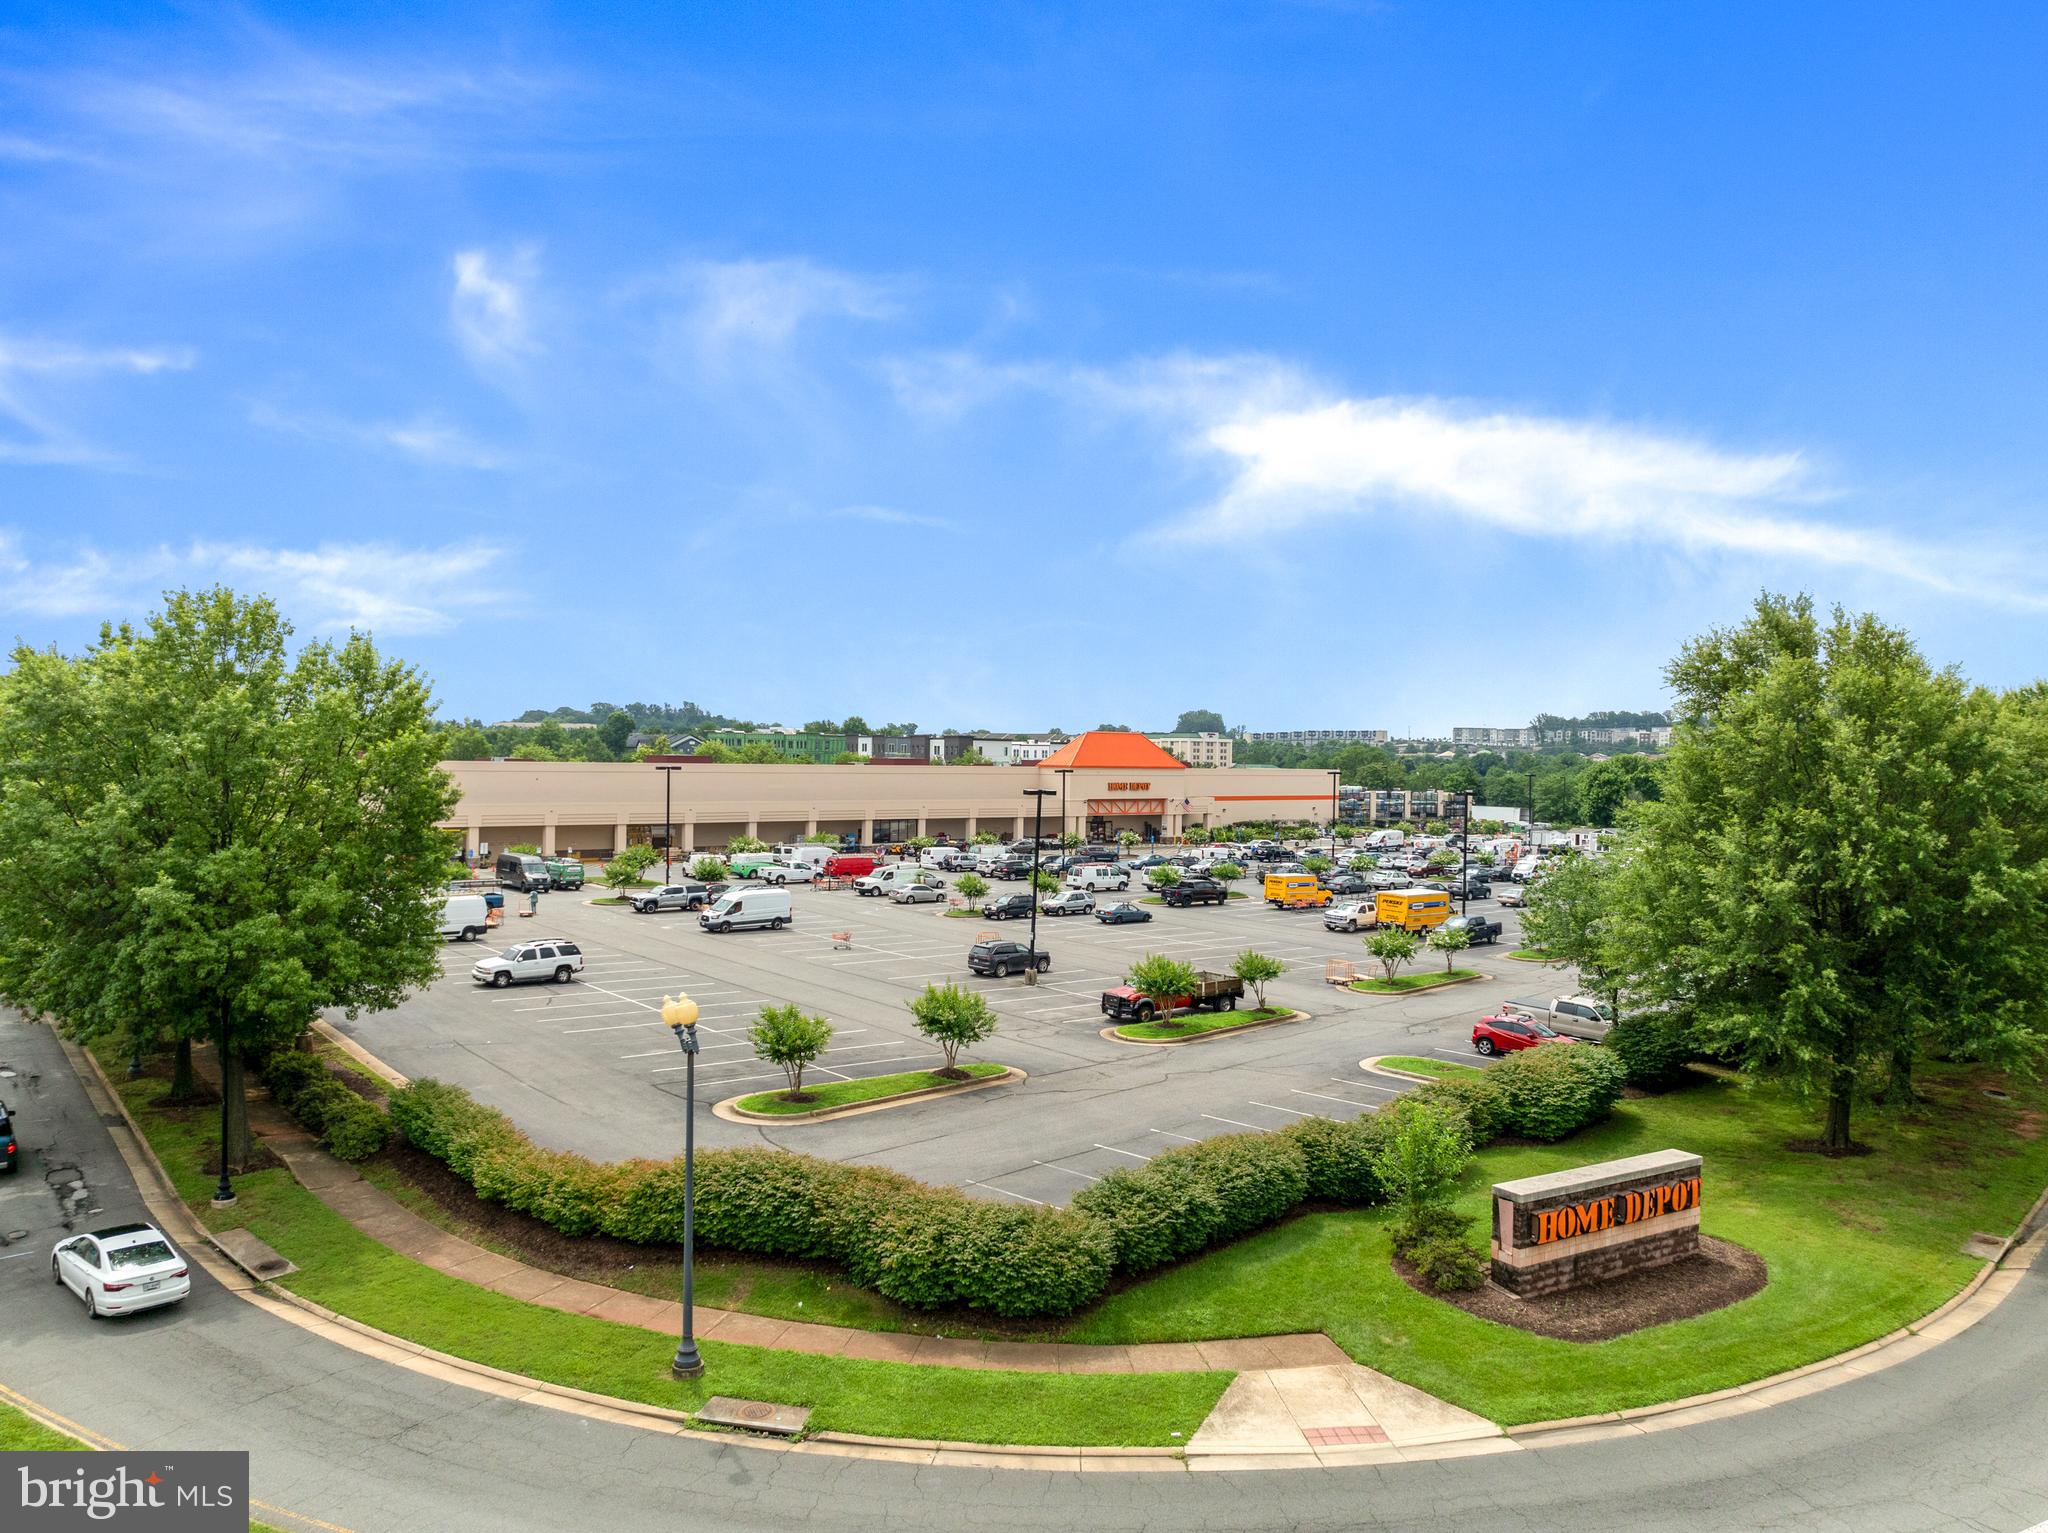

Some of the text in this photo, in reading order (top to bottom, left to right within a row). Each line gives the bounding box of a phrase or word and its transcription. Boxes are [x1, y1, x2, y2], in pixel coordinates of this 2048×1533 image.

[1107, 782, 1128, 791] HOME
[1536, 1177, 1703, 1245] HOME DEPOT
